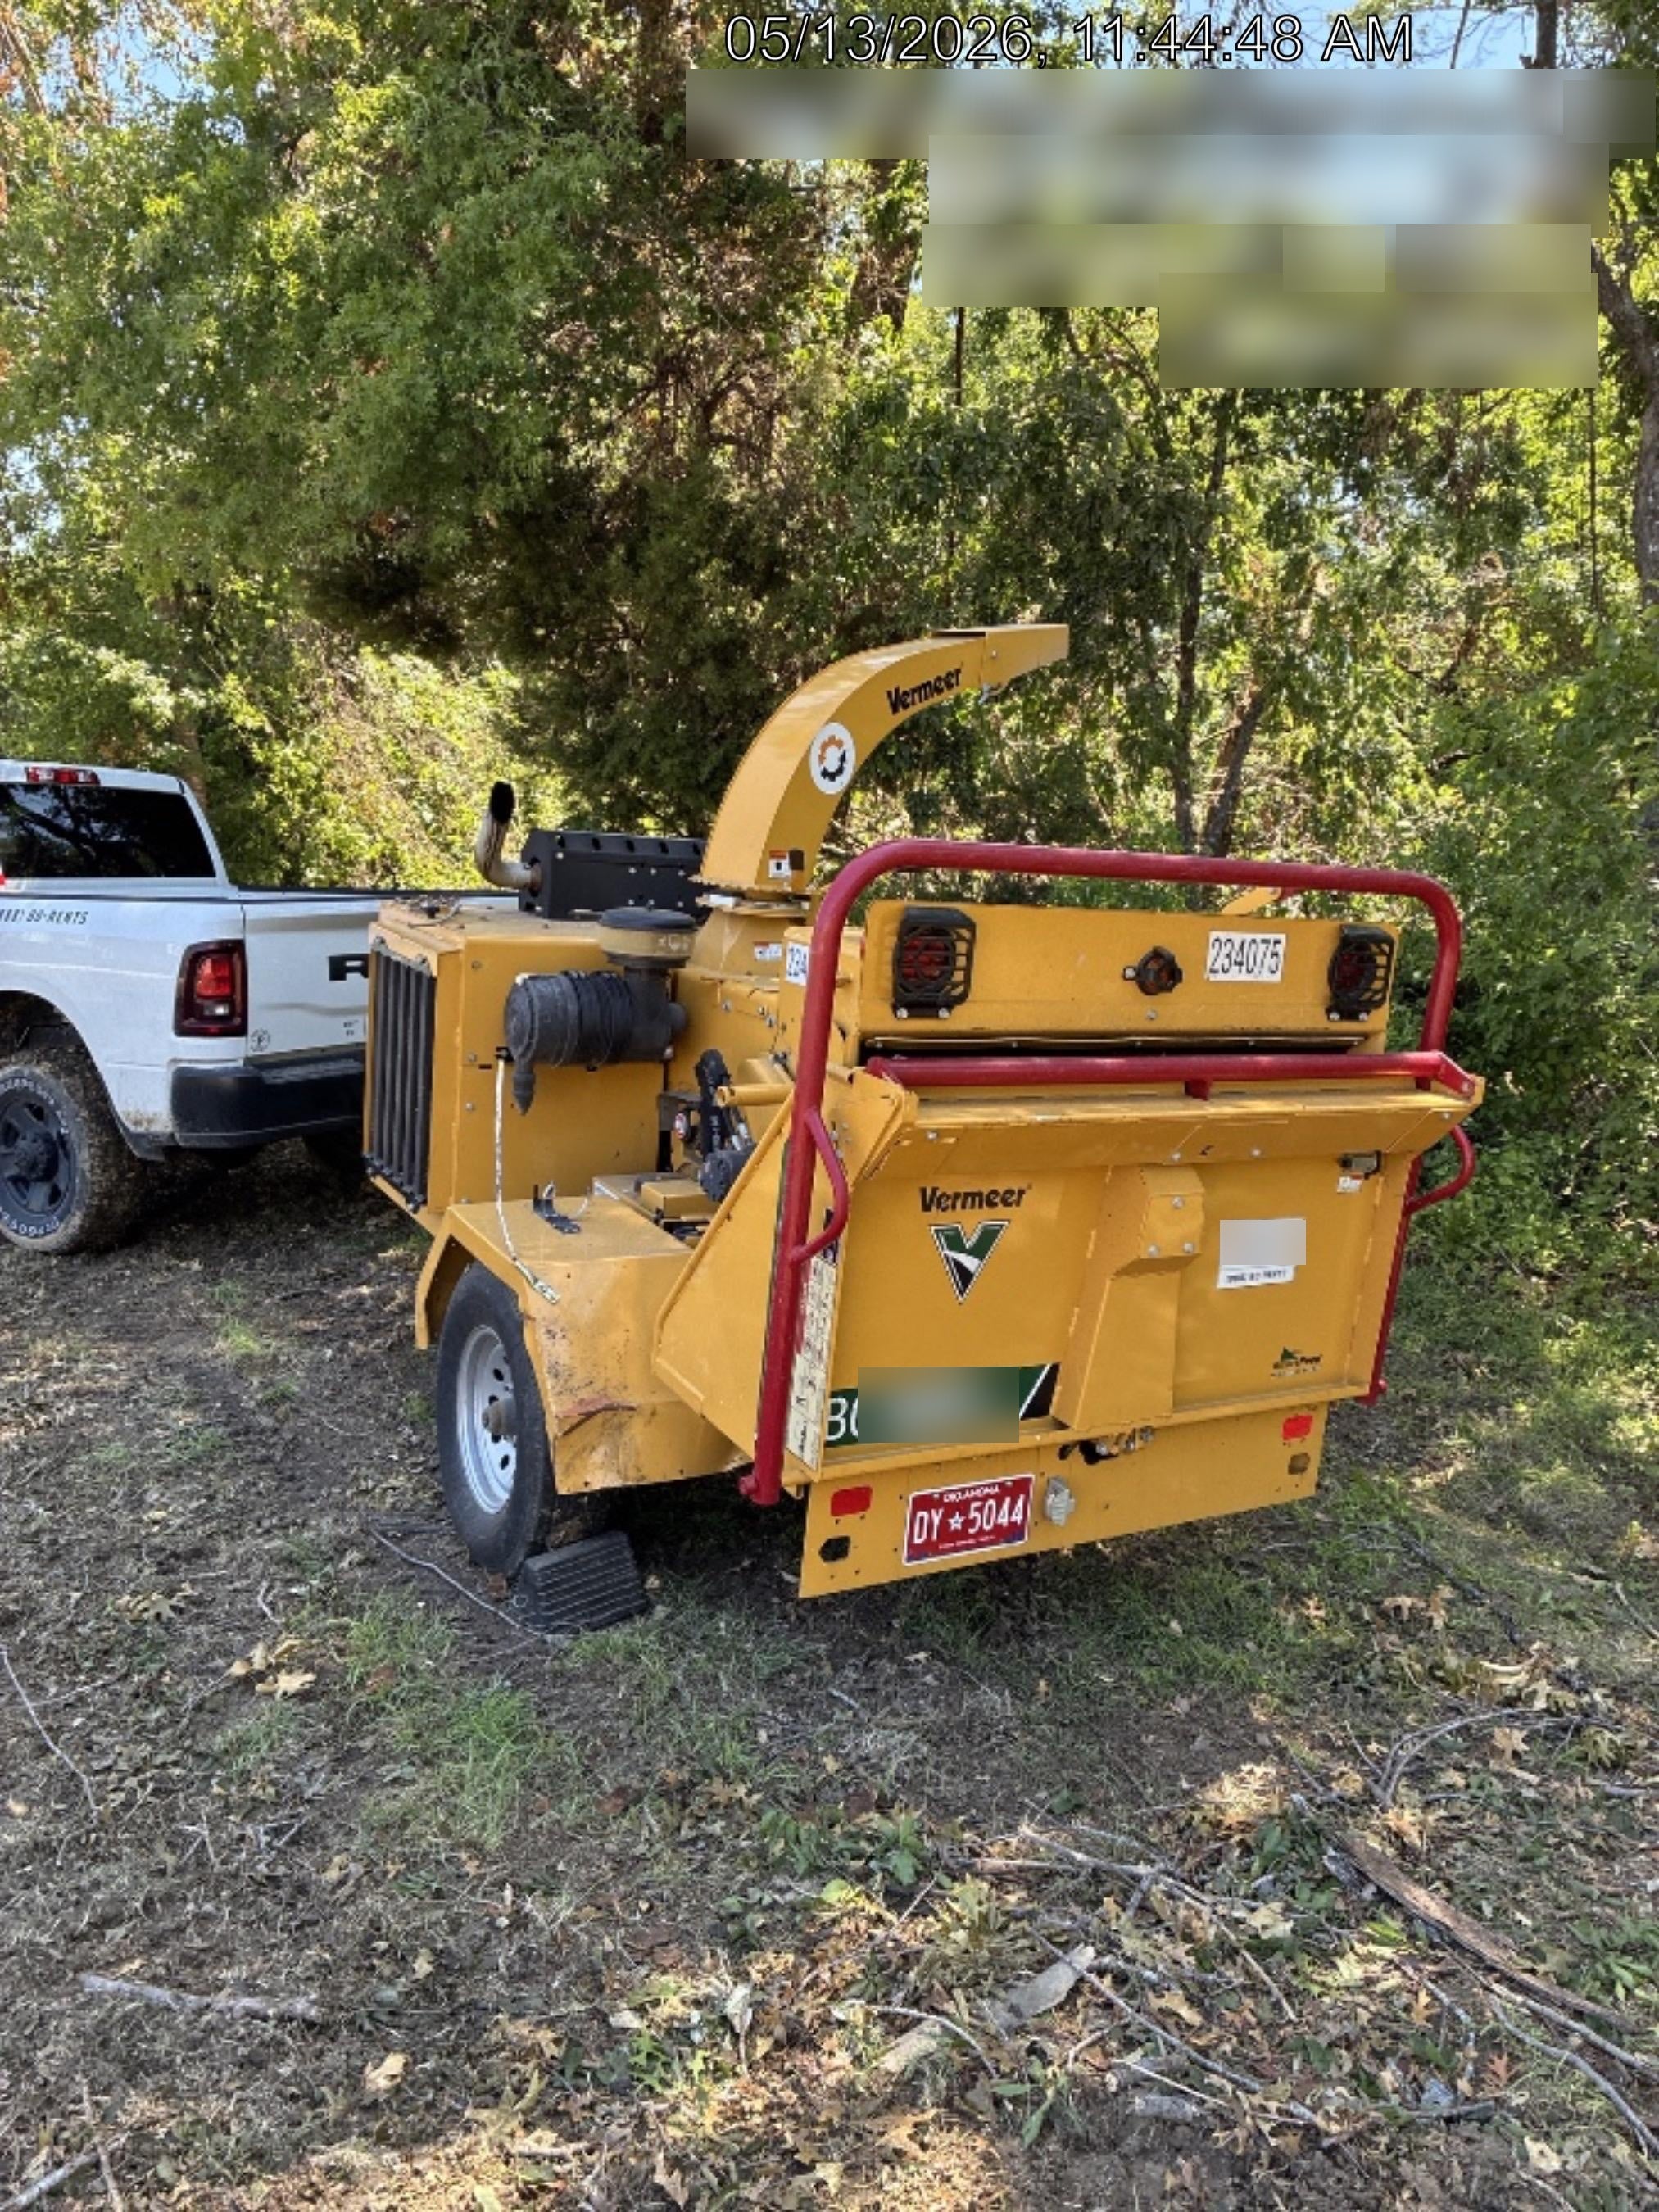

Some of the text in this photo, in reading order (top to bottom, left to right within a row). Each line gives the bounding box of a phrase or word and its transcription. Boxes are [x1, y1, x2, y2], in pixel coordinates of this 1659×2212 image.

[887, 665, 963, 715] Vermeer
[1208, 937, 1281, 977] 234075
[919, 1185, 1027, 1213] Vermeer
[913, 1494, 1026, 1545] DY 5044
